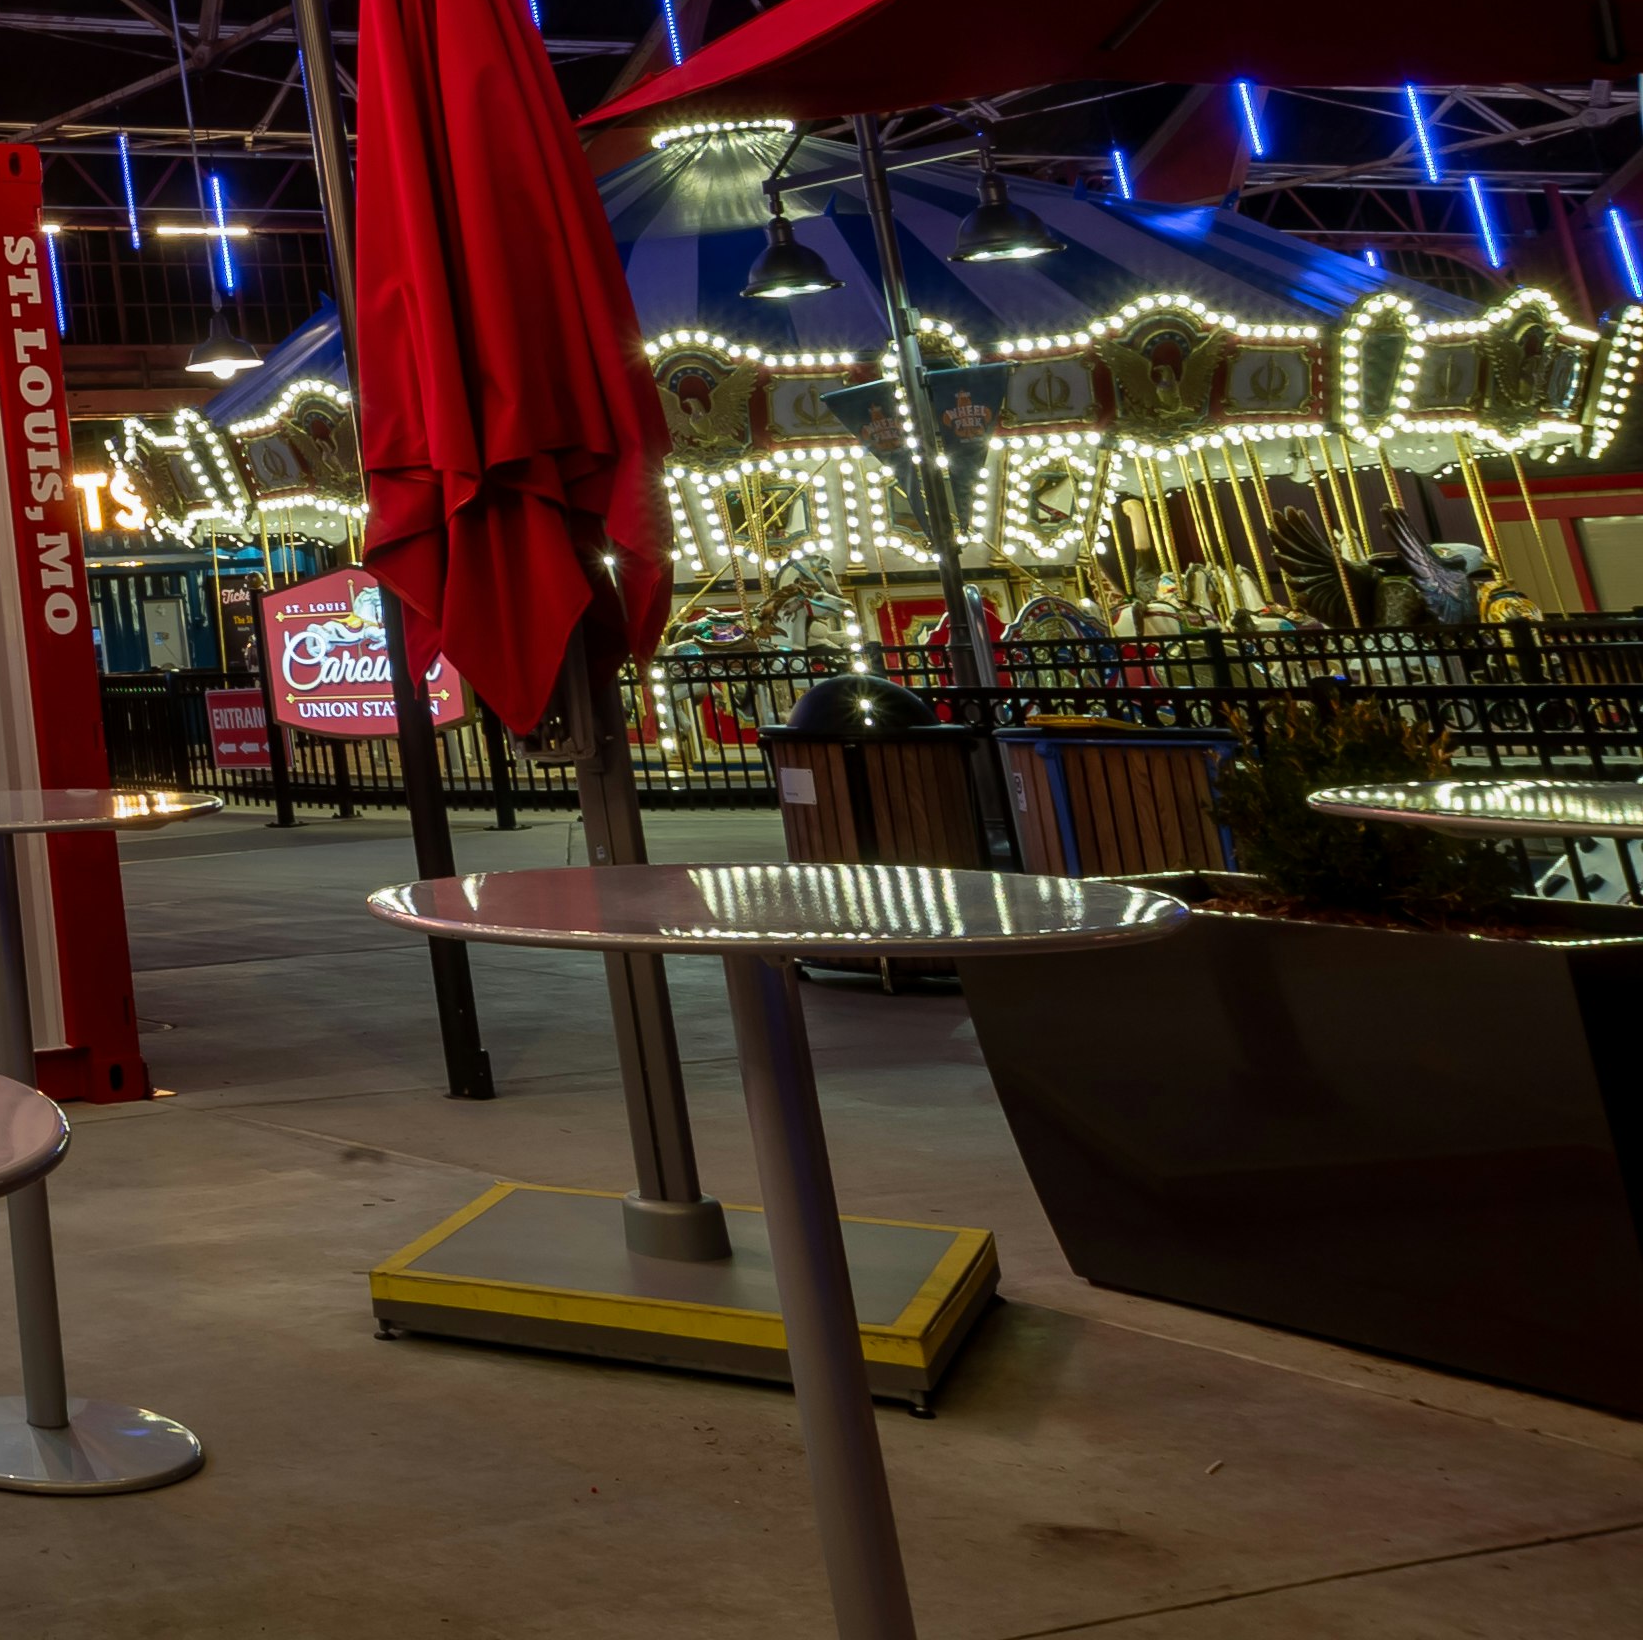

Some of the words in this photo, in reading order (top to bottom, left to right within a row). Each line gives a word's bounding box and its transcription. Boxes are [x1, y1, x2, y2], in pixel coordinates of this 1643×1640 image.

[3, 236, 42, 317] ST.
[13, 328, 64, 521] LOUIS,
[954, 417, 983, 429] PARK
[39, 531, 78, 635] MO
[221, 588, 251, 604] Ticke
[285, 603, 304, 614] ST.
[309, 601, 347, 613] LOUIS
[282, 631, 442, 691] Carou
[213, 708, 266, 729] ENTRAN
[298, 702, 358, 718] UNION
[362, 700, 440, 717] STAN
